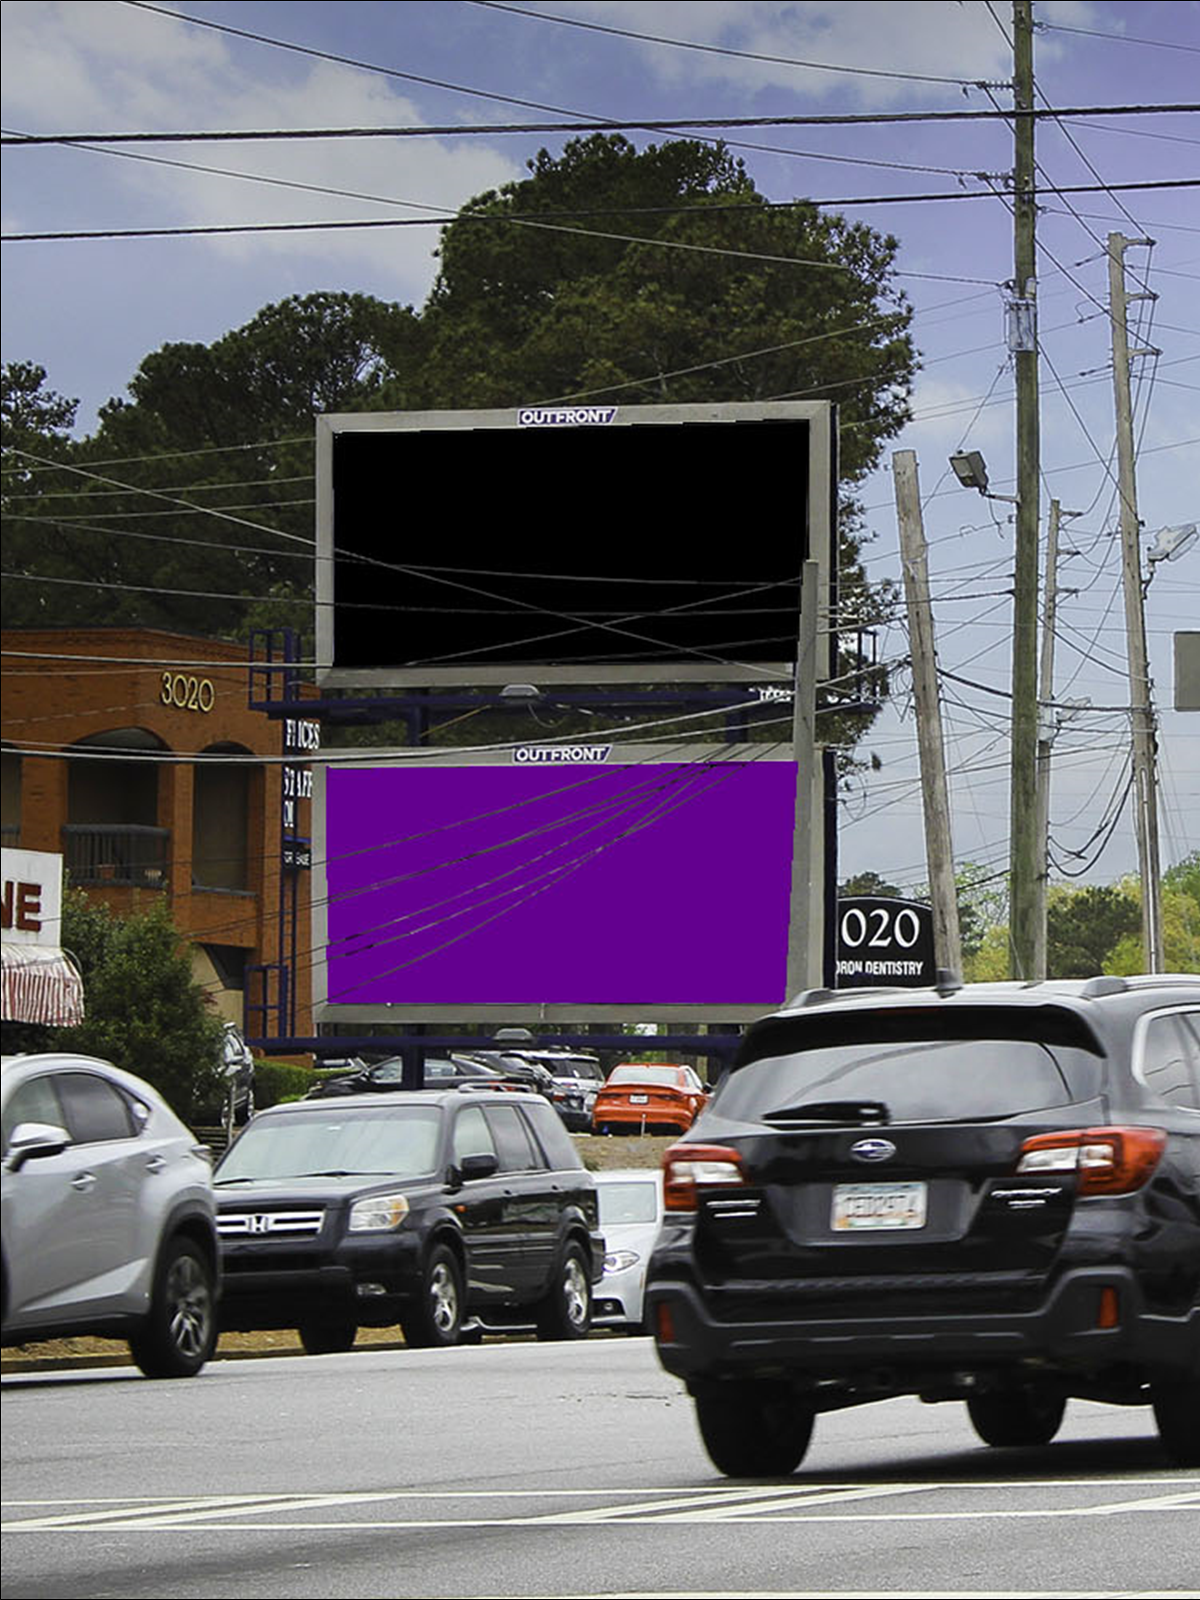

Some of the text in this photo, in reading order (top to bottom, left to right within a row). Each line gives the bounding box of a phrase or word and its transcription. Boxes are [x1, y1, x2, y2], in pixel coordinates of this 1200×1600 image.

[521, 408, 612, 424] OUTFRONT
[162, 672, 214, 712] 3020
[516, 747, 606, 762] OUTFRONT
[841, 908, 919, 948] 020
[865, 960, 924, 976] DENTISTRY
